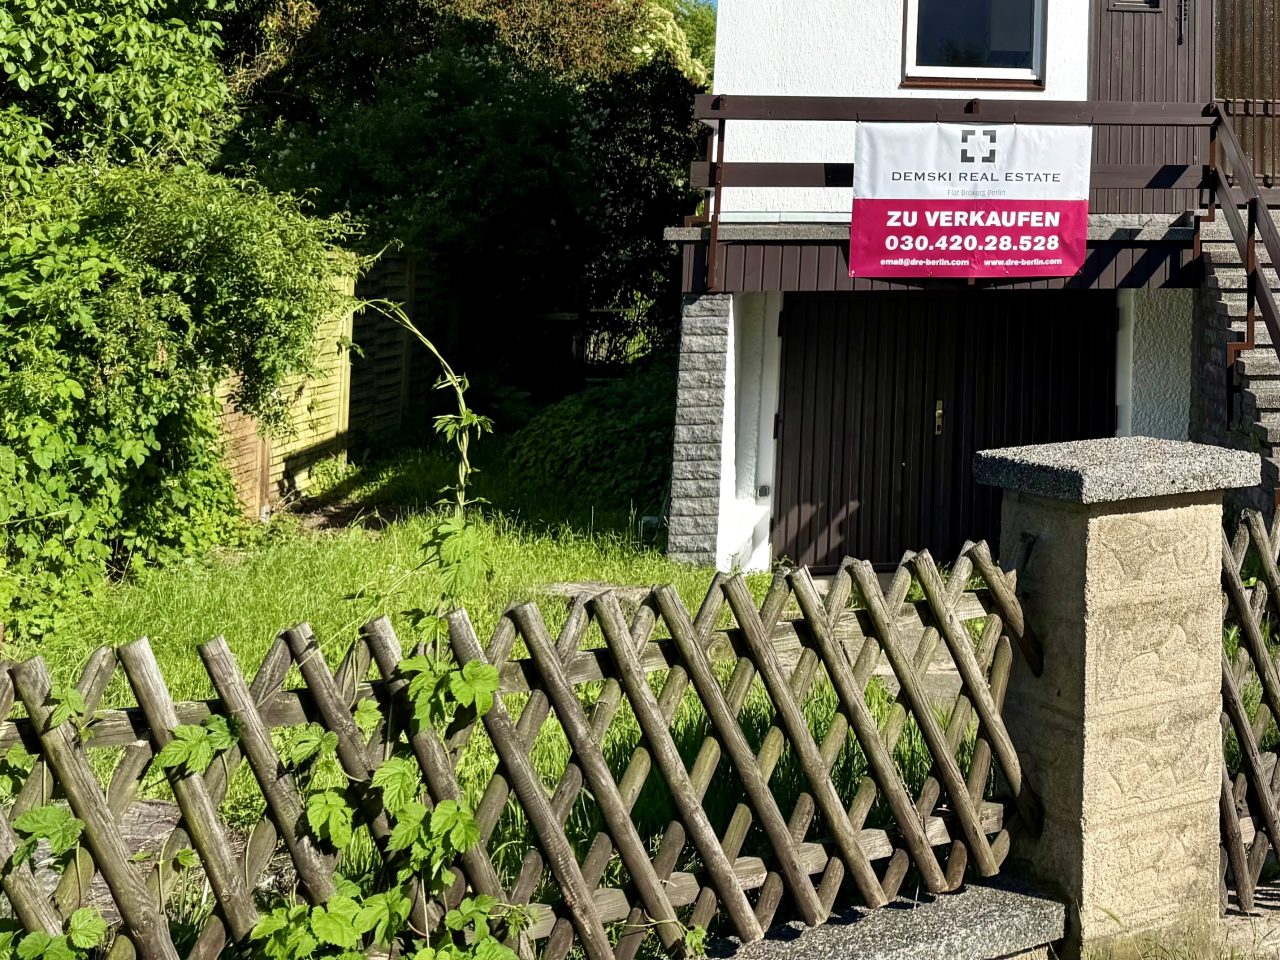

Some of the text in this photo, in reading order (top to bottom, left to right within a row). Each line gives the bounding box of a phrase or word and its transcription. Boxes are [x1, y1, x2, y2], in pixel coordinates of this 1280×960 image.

[891, 171, 1061, 183] DEMSKI REAL ESTATE
[886, 210, 1060, 227] ZU VERKAUFEN
[884, 234, 1060, 251] 030.420.28.528
[880, 258, 1063, 267] email@dre-berlin.com www.dre-berlin.com
